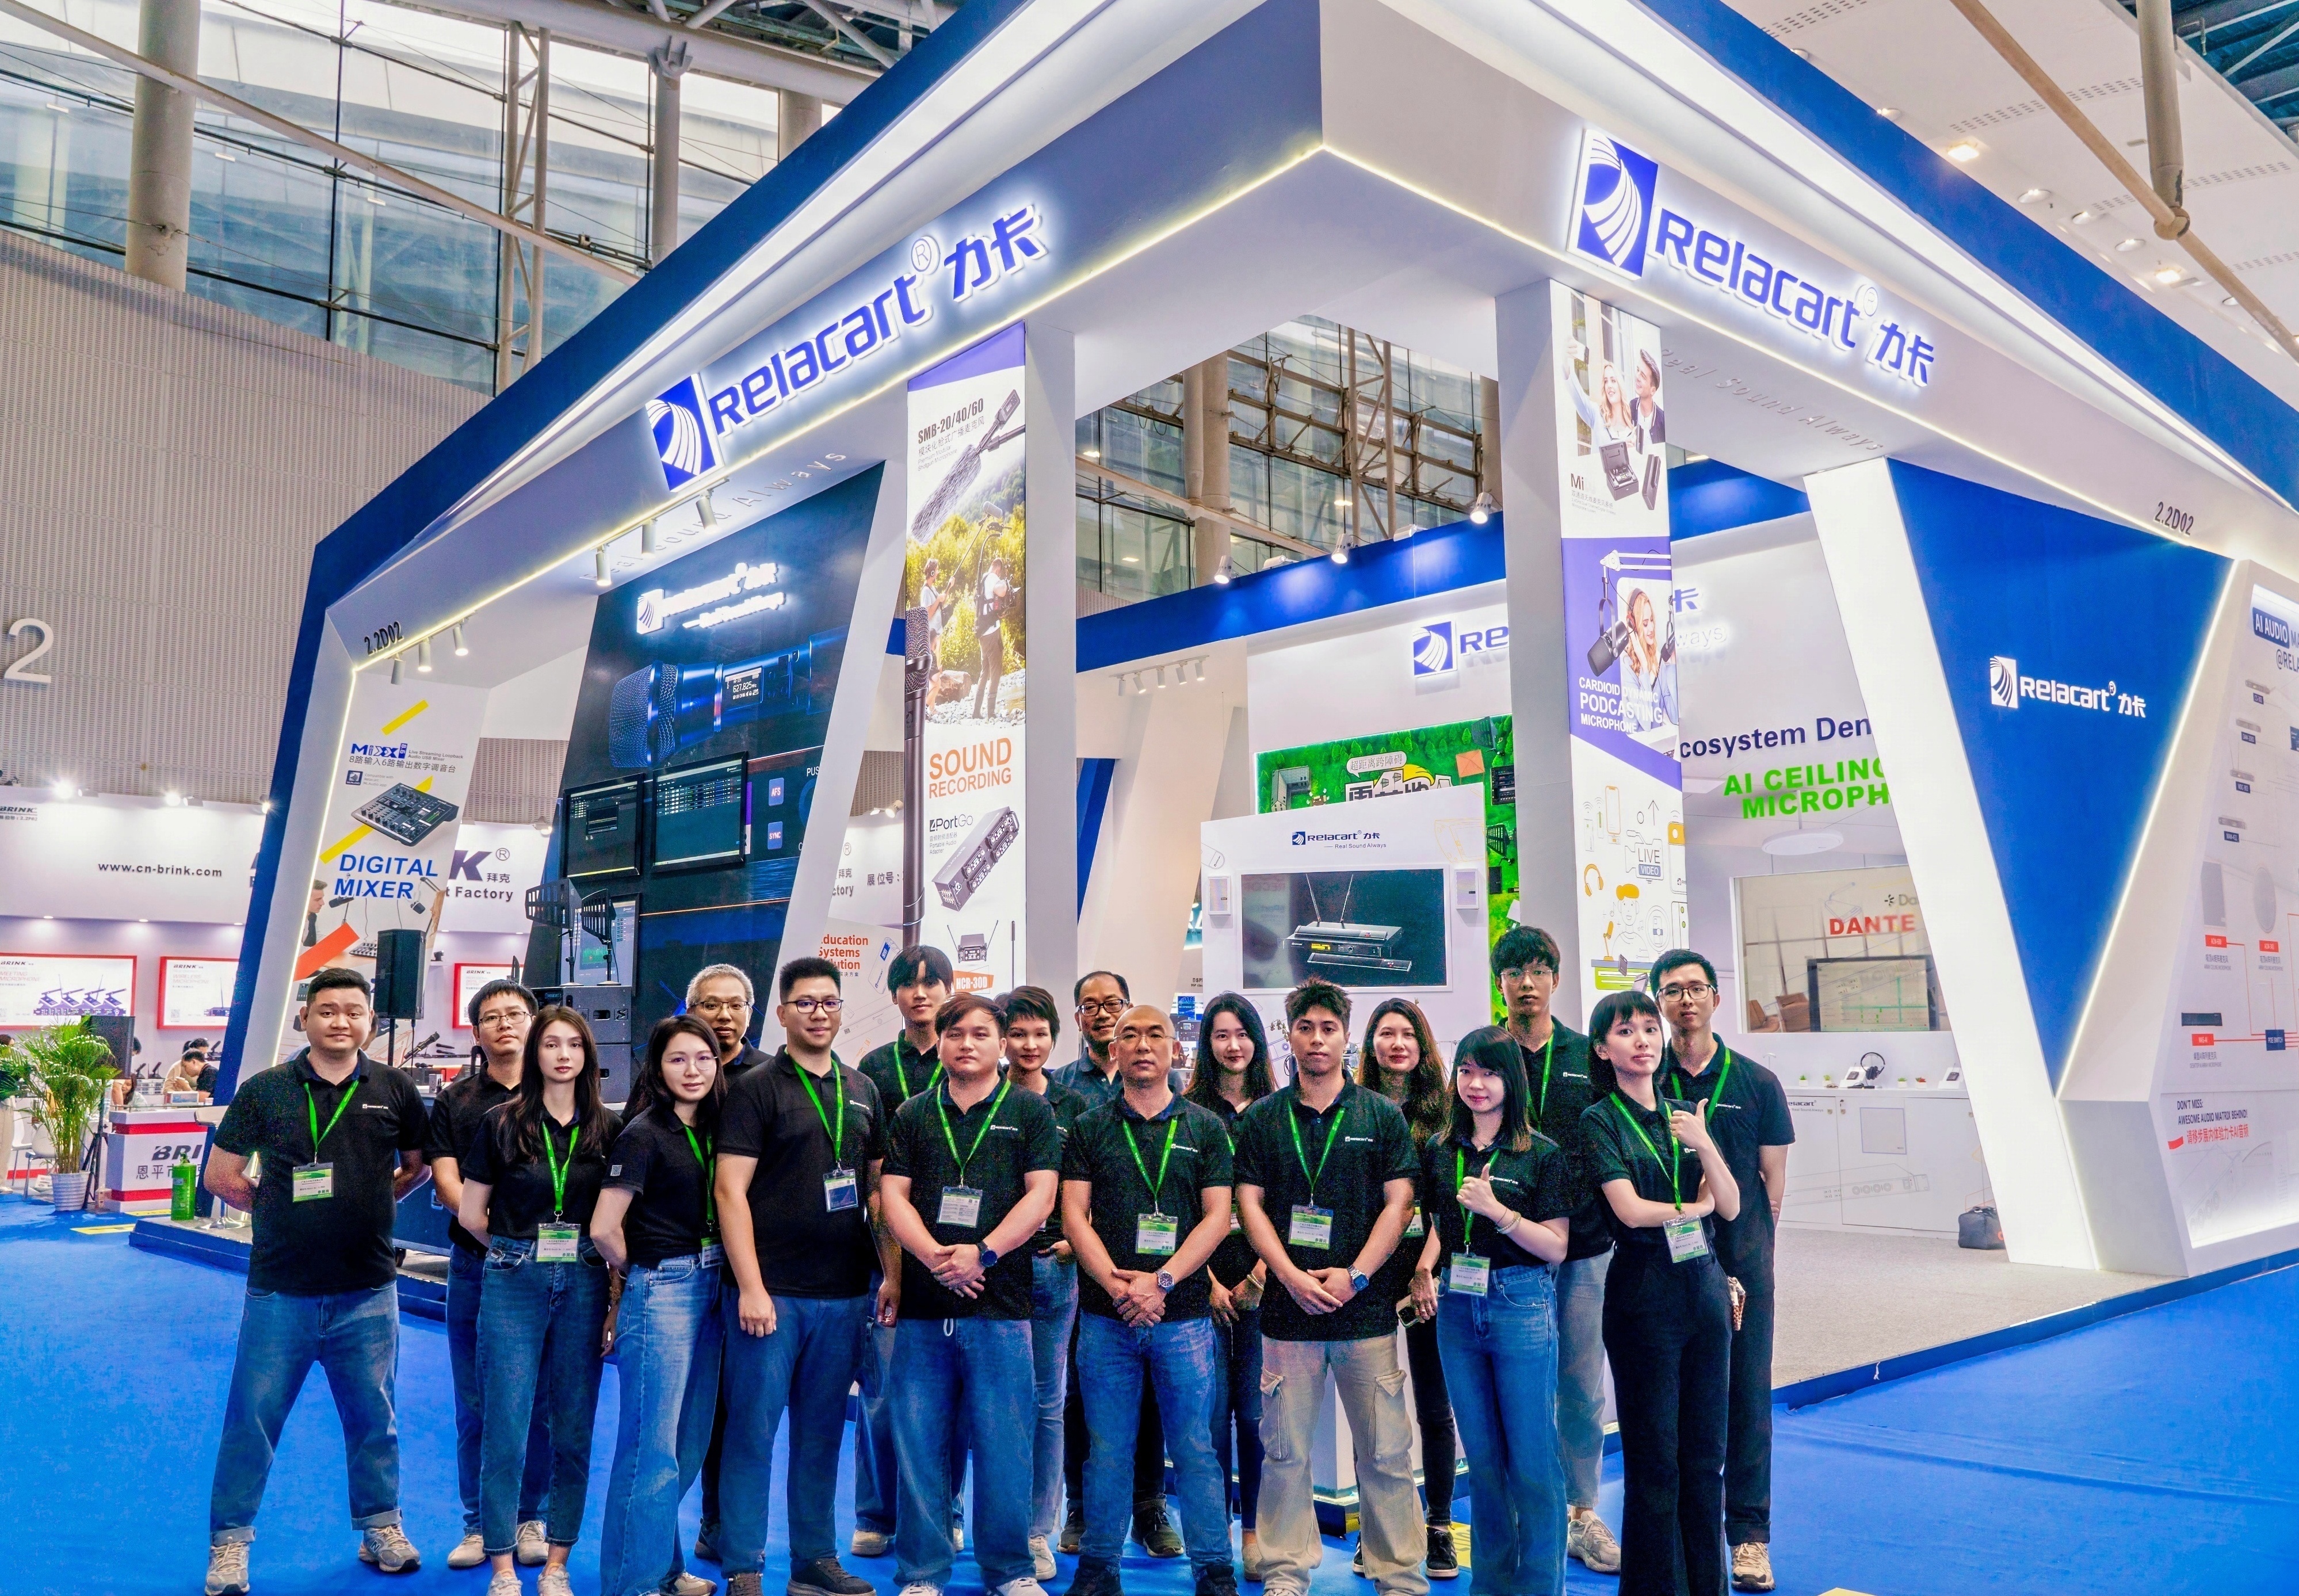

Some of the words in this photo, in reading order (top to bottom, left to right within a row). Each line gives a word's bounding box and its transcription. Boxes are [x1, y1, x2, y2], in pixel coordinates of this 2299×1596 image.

[944, 204, 1040, 302] 力卡
[1878, 321, 1935, 387] 力卡
[918, 398, 984, 444] SMB-20/40/60
[1798, 415, 1884, 450] Always
[732, 452, 847, 507] Always
[2155, 501, 2195, 536] 2.2D02
[364, 621, 404, 655] 2.2D02
[2254, 613, 2266, 633] AI
[2265, 617, 2288, 644] AUDIO
[4, 617, 55, 684] 2
[733, 681, 752, 693] 627.825
[1579, 676, 1621, 696] CARDIOID
[1622, 685, 1659, 703] DYNAMIC
[1580, 692, 1663, 723] PODCASTING
[2118, 693, 2147, 718] 力卡
[1581, 713, 1637, 734] MICROPHONE
[349, 755, 456, 773] 8路输入6路输出数字调音台
[929, 737, 1013, 780] SOUND
[1350, 754, 1403, 771] 超距离跨障碍
[771, 787, 781, 797] AFS
[929, 767, 1013, 800] RECORDING
[1724, 770, 1752, 796] AI
[769, 831, 781, 840] SYNC
[929, 841, 945, 850] Portable
[1363, 831, 1381, 840] 力卡
[338, 853, 439, 878] DIGITAL
[1639, 848, 1660, 864] LIVE
[98, 863, 223, 878] www.cn-brink.com
[487, 872, 511, 883] 拜克
[1641, 866, 1659, 876] VIDEO
[334, 878, 414, 900] MIXER
[455, 886, 514, 902] Factory
[1828, 914, 1916, 936] DANTE
[956, 976, 988, 990] HCR-30D
[2177, 1099, 2191, 1110] DON'T
[2191, 1099, 2203, 1109] MISS:
[2178, 1113, 2200, 1125] AWESOME
[2201, 1112, 2214, 1122] AUDIO
[2215, 1110, 2231, 1121] MATRIX
[2231, 1109, 2248, 1120] BEHIND!
